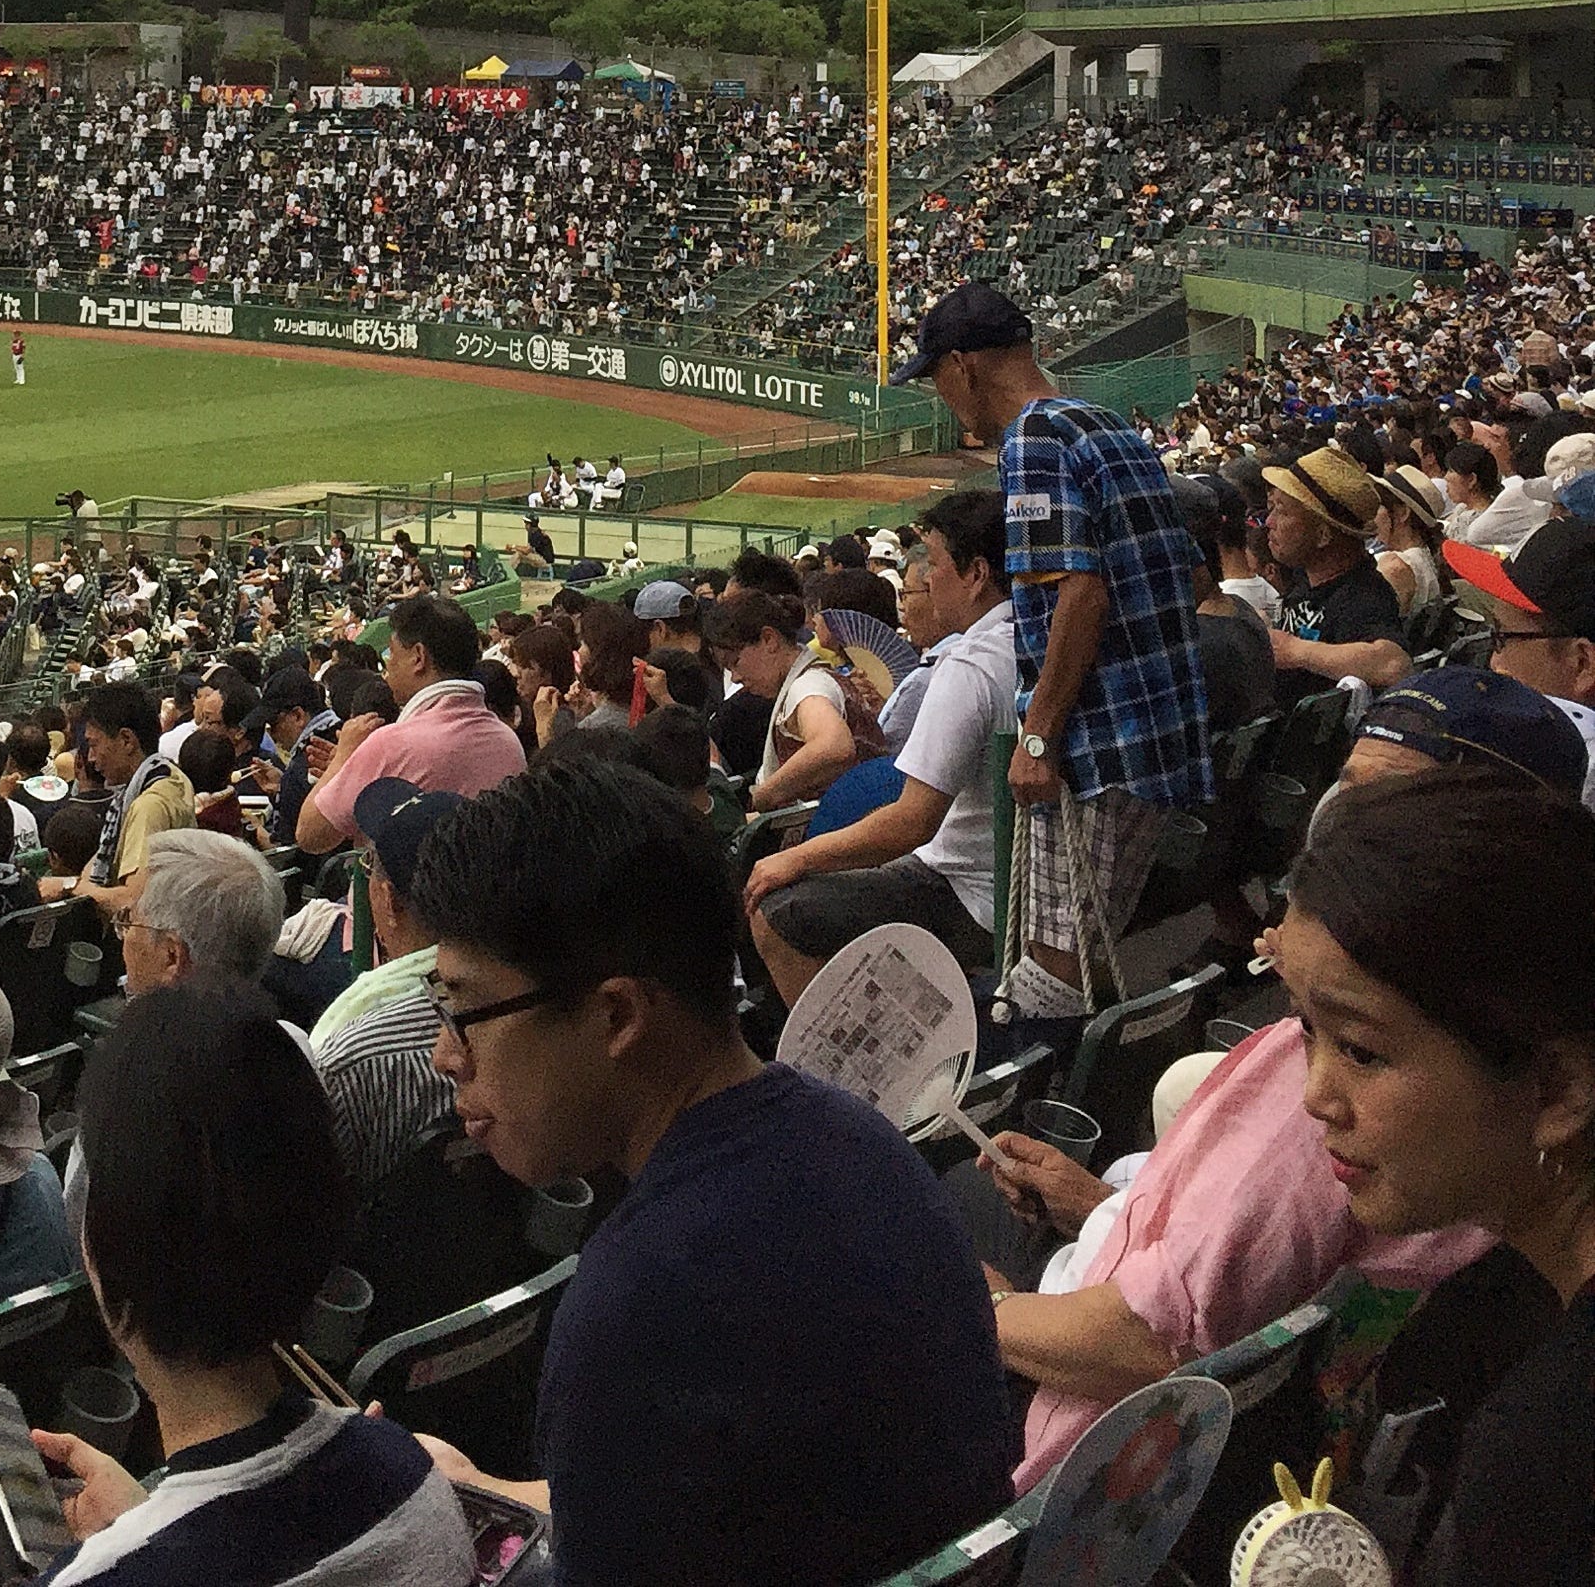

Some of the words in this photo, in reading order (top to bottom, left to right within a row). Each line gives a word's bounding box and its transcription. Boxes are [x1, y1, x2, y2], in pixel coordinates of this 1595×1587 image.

[79, 296, 234, 335] カーコンビニ倶楽部
[455, 332, 524, 362] タクシーは
[551, 339, 626, 380] 第一交通
[680, 360, 746, 396] XYLITOL
[754, 373, 824, 408] LOTTE
